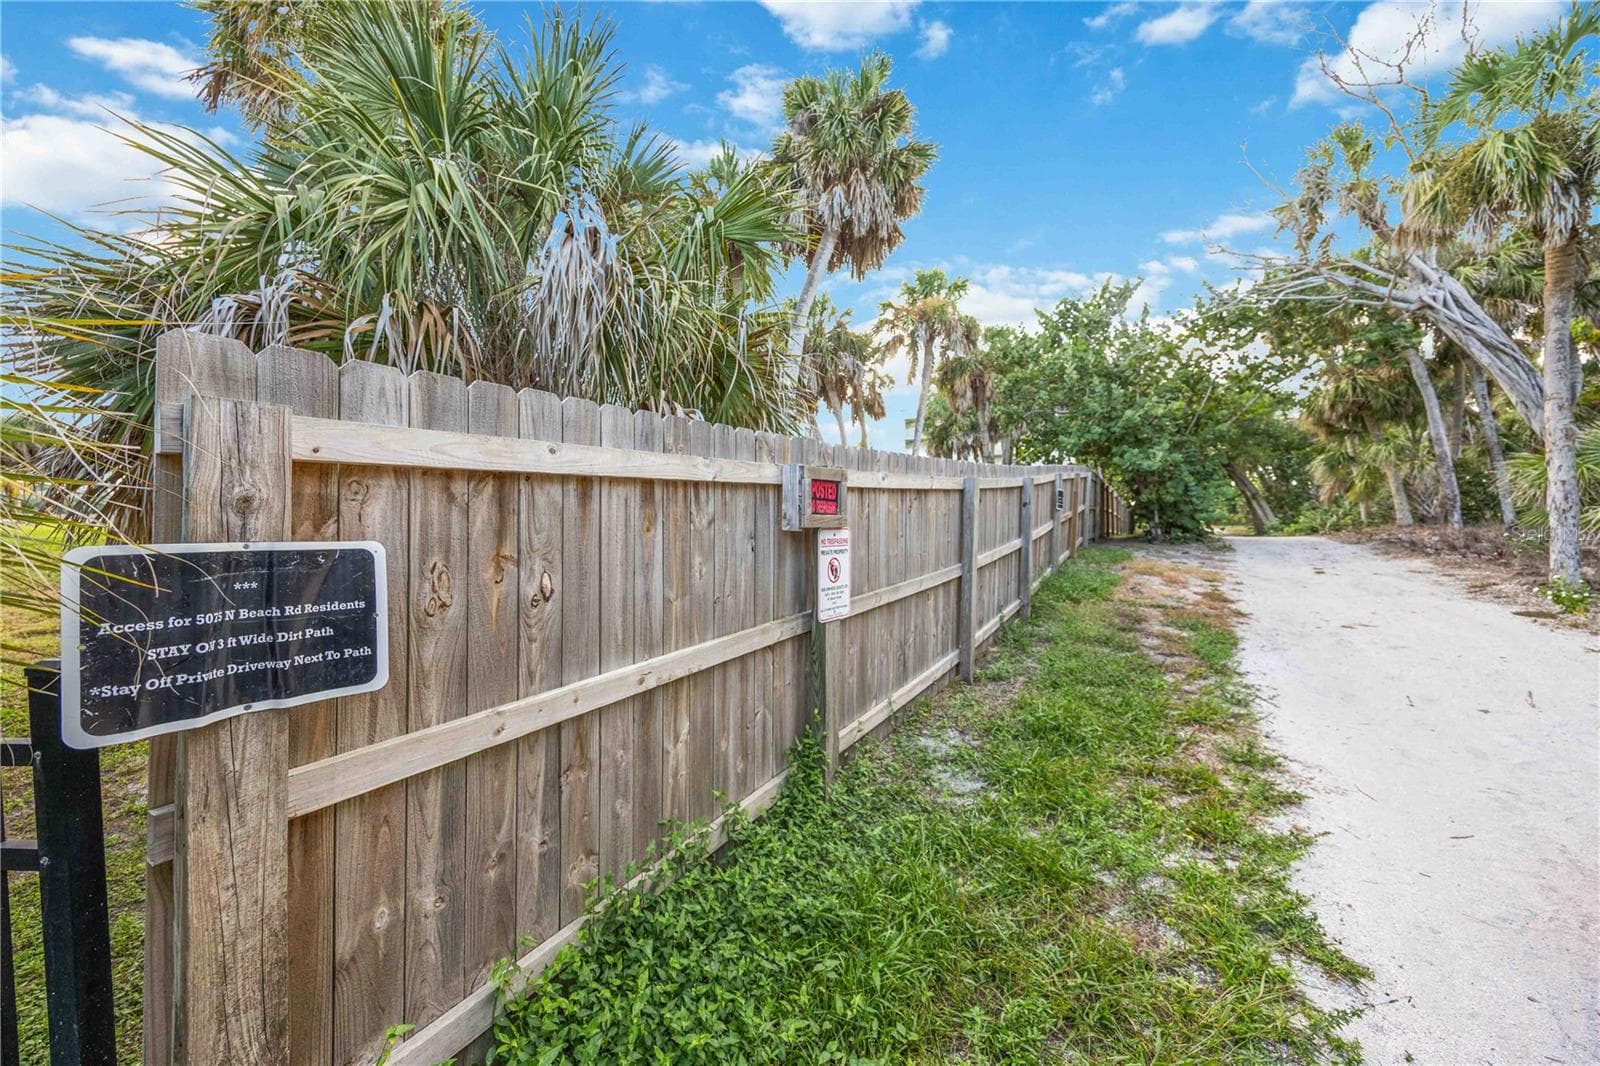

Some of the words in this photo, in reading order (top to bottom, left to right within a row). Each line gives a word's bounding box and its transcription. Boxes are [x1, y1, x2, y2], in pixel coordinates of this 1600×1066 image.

[96, 619, 164, 636] Access
[168, 616, 192, 628] for
[224, 610, 236, 621] N
[239, 606, 281, 619] Beach
[284, 604, 302, 616] Rd
[304, 599, 366, 614] Residents
[147, 643, 192, 660] STAY
[217, 639, 224, 649] 3
[226, 636, 237, 648] ft
[238, 633, 274, 646] Wide
[276, 630, 303, 643] Dirt
[304, 626, 334, 639] Path
[145, 676, 174, 690] Off
[175, 668, 225, 685] Private
[226, 660, 291, 676] Driveway
[293, 652, 323, 667] Next
[324, 650, 341, 661] To
[343, 646, 372, 658] Path
